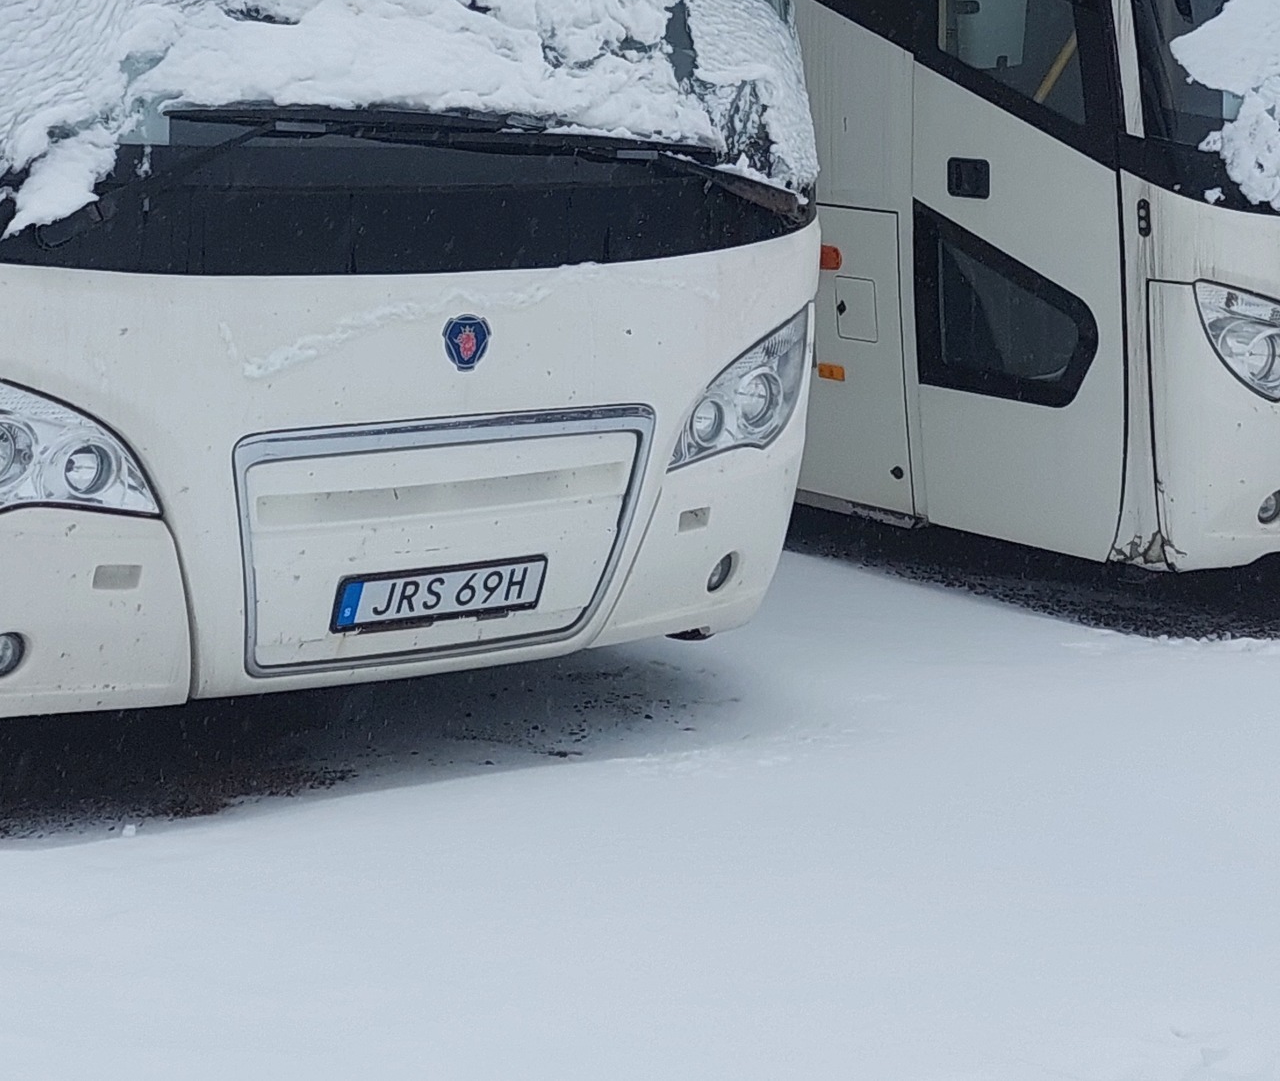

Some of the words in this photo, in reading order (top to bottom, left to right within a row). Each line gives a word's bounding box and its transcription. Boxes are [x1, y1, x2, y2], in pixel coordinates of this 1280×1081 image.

[372, 577, 446, 616] JRS
[454, 566, 529, 607] 69H
[343, 607, 352, 618] S
